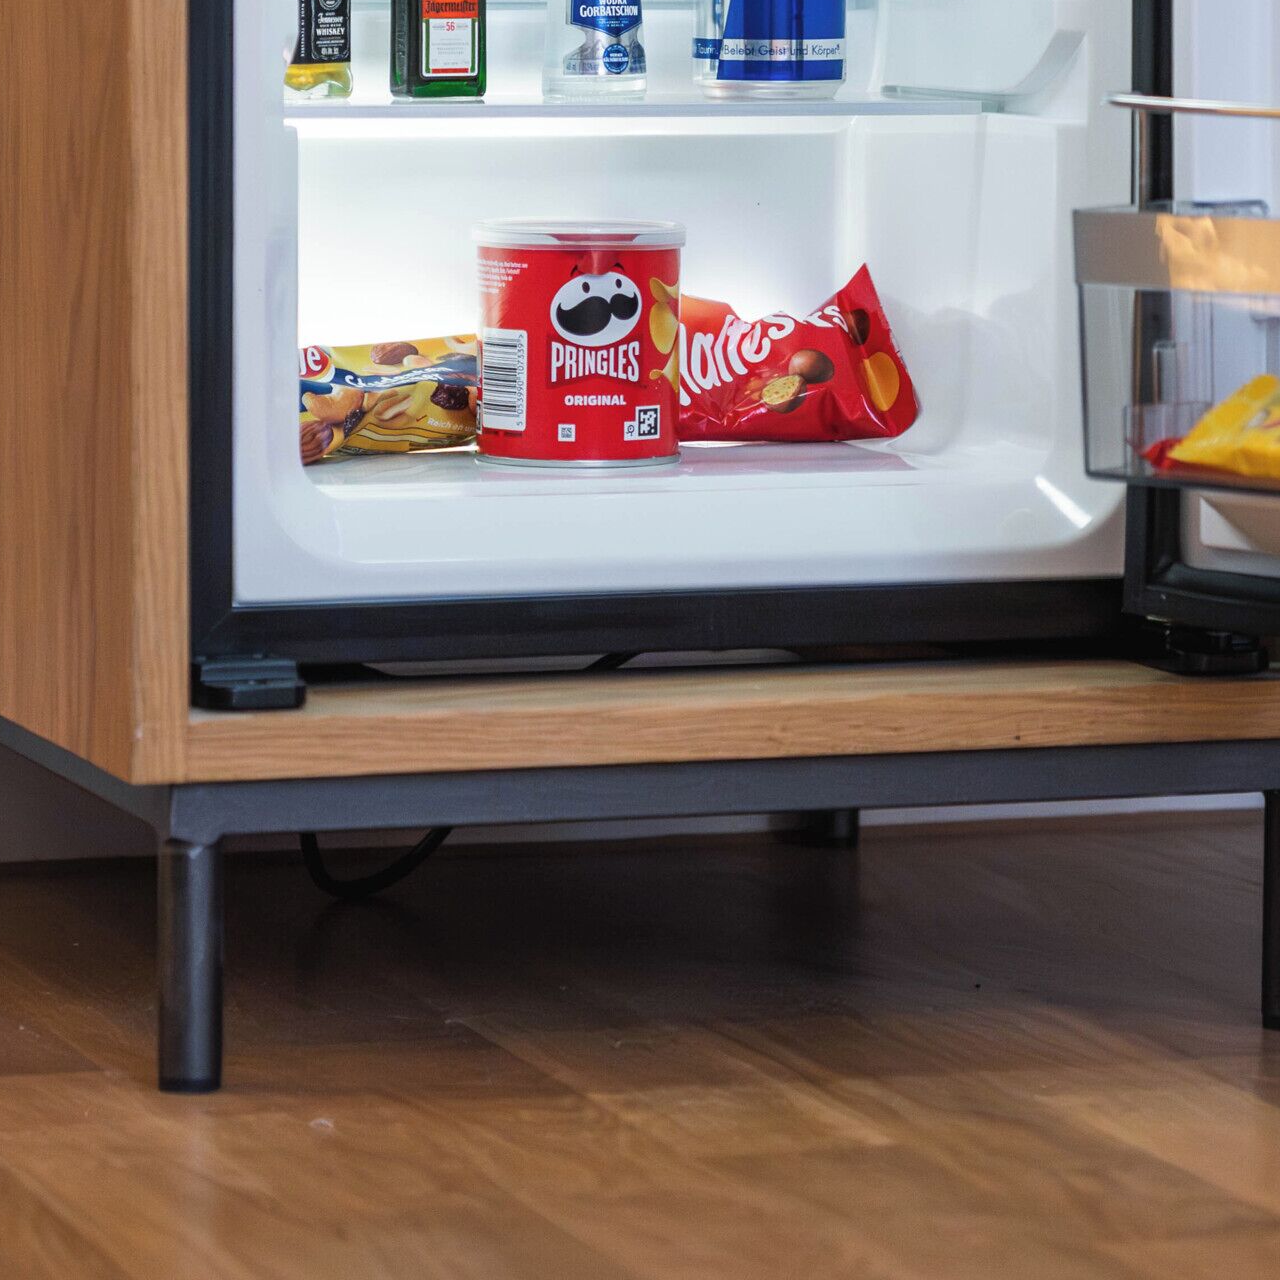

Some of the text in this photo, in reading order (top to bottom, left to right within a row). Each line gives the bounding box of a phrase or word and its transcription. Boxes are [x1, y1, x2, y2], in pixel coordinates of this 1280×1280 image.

[579, 5, 639, 18] GORBATSCHOW
[316, 28, 345, 36] WHISKEY
[446, 21, 456, 31] 56
[723, 44, 755, 56] Belebt
[758, 44, 786, 56] Geist
[790, 44, 809, 56] und
[551, 340, 640, 383] PRINGLES
[564, 394, 627, 406] ORIGINAL
